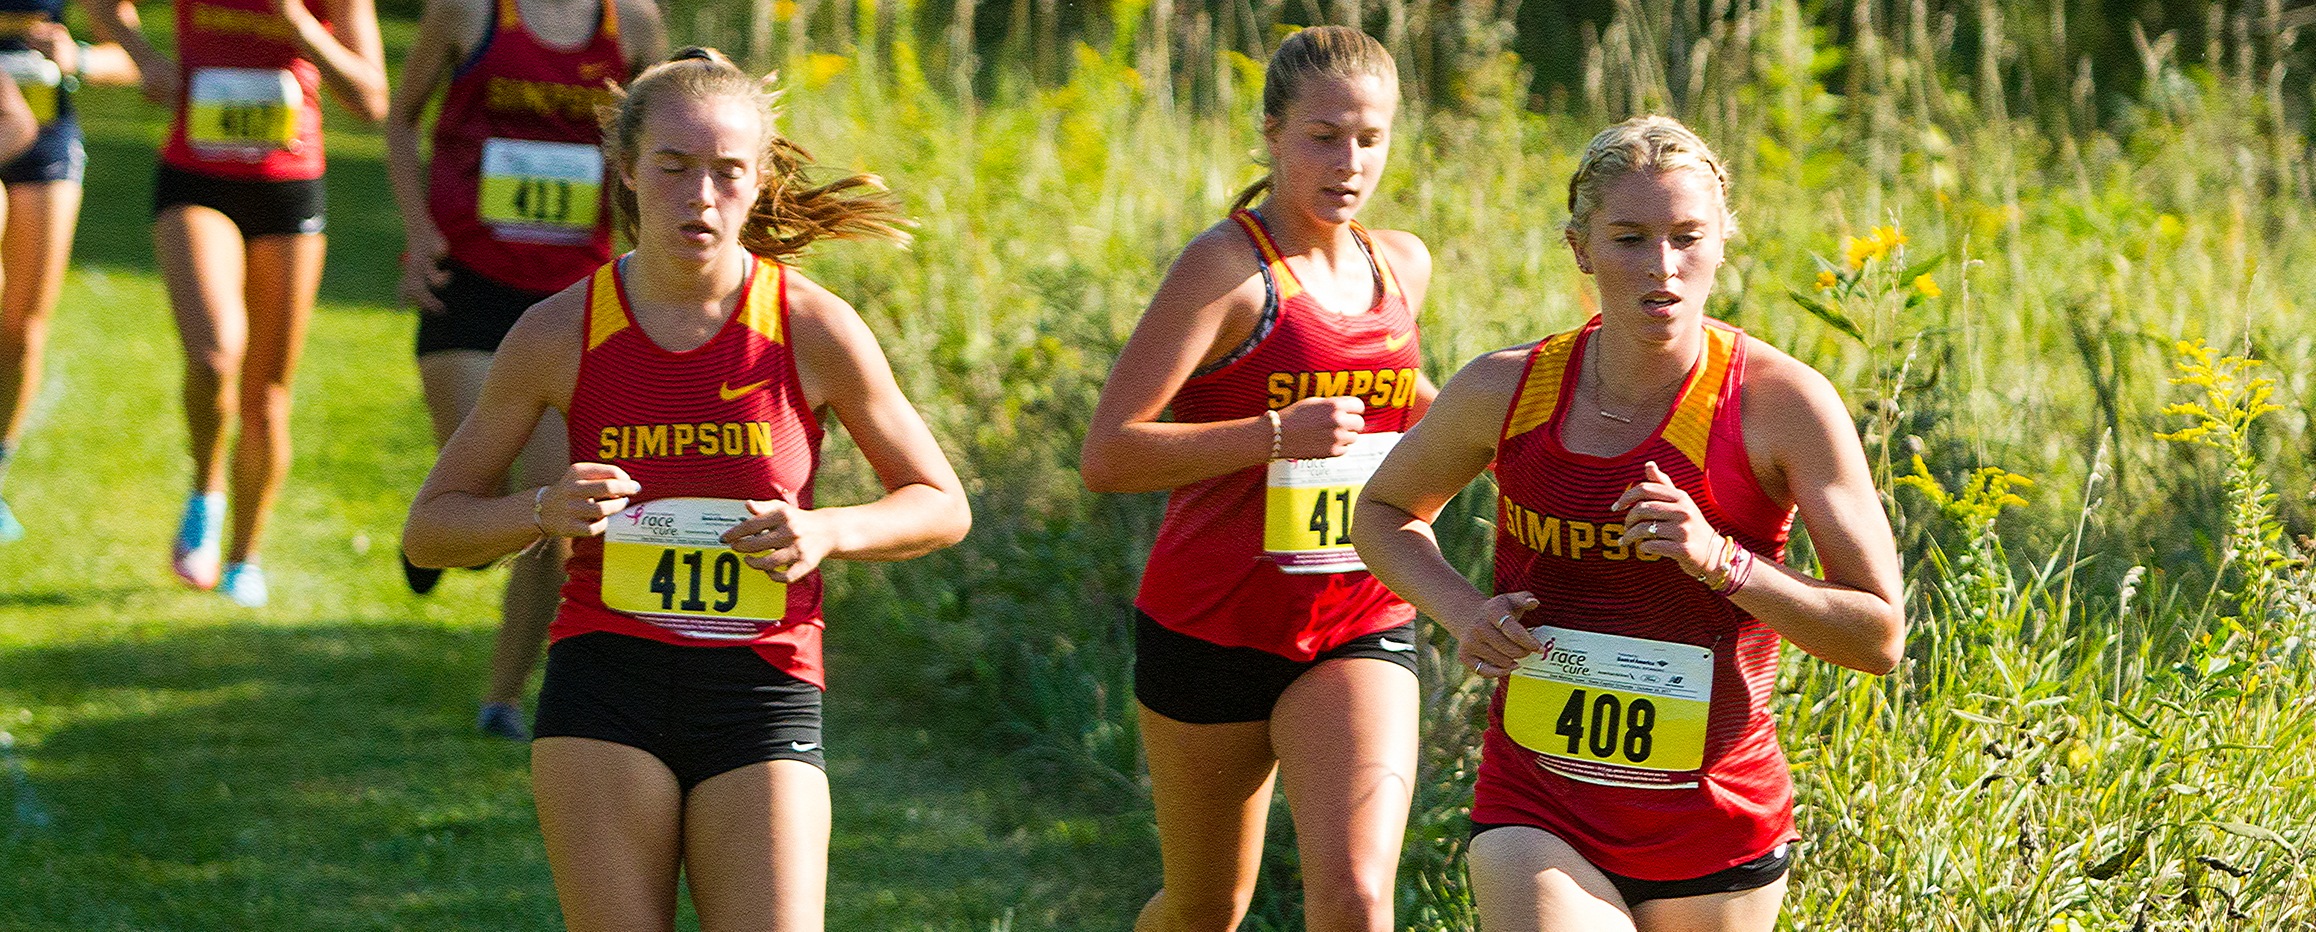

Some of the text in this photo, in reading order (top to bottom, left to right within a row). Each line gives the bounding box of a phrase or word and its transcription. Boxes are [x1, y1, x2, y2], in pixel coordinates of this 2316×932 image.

[598, 421, 775, 460] SIMPSON
[641, 515, 674, 527] race
[650, 548, 741, 613] 419
[1551, 651, 1586, 667] race
[1555, 688, 1656, 764] 408
